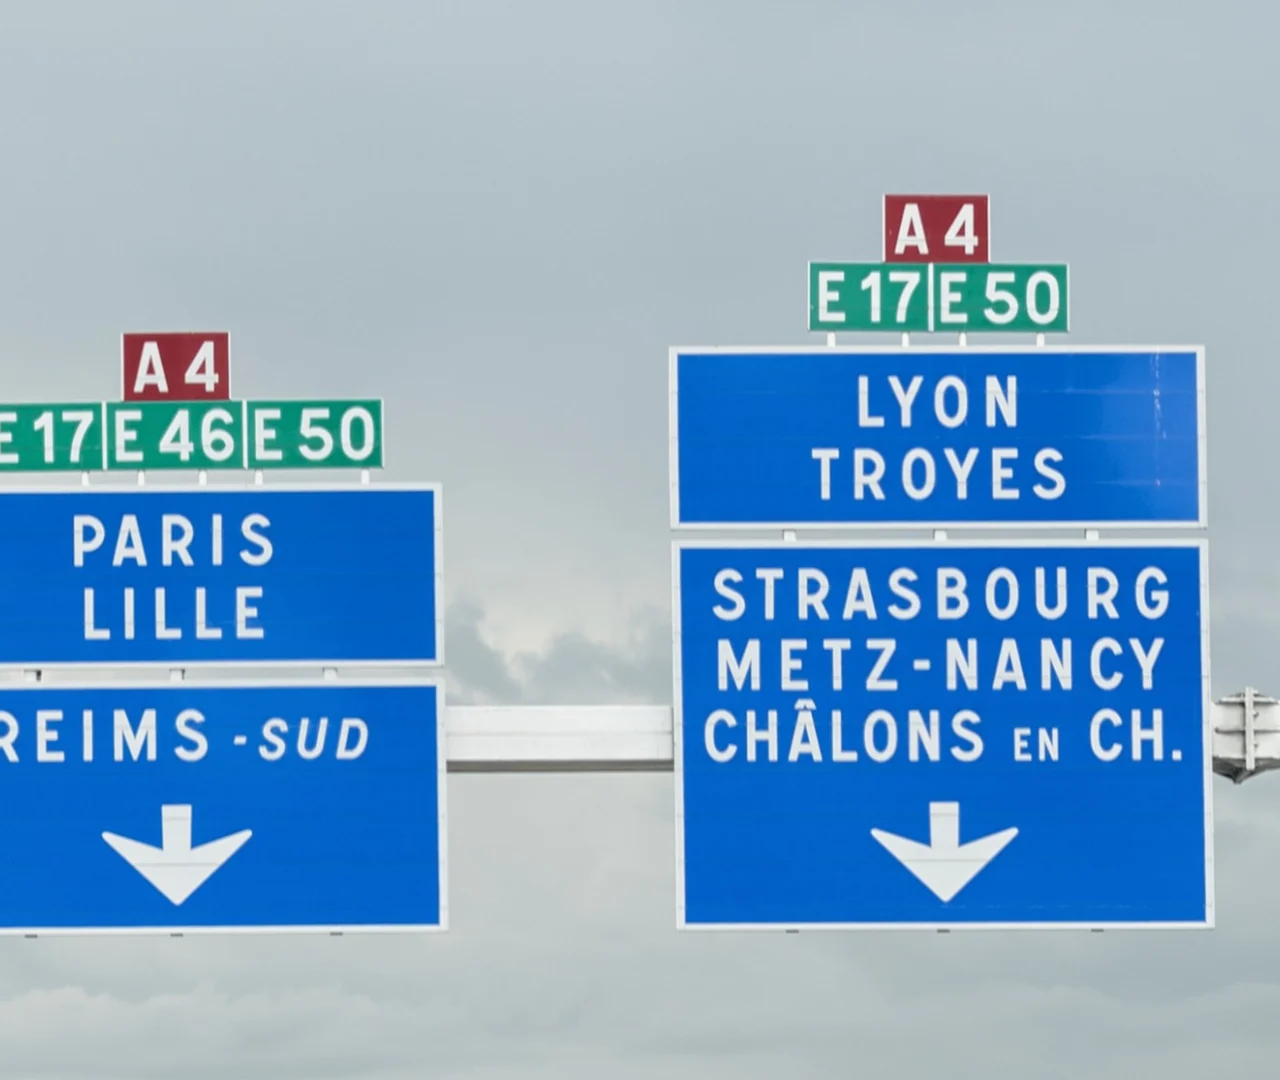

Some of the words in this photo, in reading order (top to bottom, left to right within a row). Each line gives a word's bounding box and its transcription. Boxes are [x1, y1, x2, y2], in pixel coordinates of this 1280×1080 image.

[893, 202, 930, 256] A
[943, 202, 980, 256] 4
[860, 270, 922, 324] 17
[983, 270, 1061, 326] 50
[132, 340, 169, 394] A
[183, 339, 220, 393] 4
[858, 375, 1017, 428] LYON
[33, 409, 94, 464] 17
[158, 407, 235, 462] 46
[298, 405, 375, 461] 50
[811, 447, 1066, 500] TROYES
[73, 513, 273, 567] PARIS
[83, 586, 264, 640] LILLE
[712, 566, 1169, 621] STRASBOURG
[717, 637, 1164, 691] METZ-NANCY
[704, 698, 984, 763] CHÂLONS
[1013, 727, 1059, 761] EN
[1090, 708, 1182, 763] CH.
